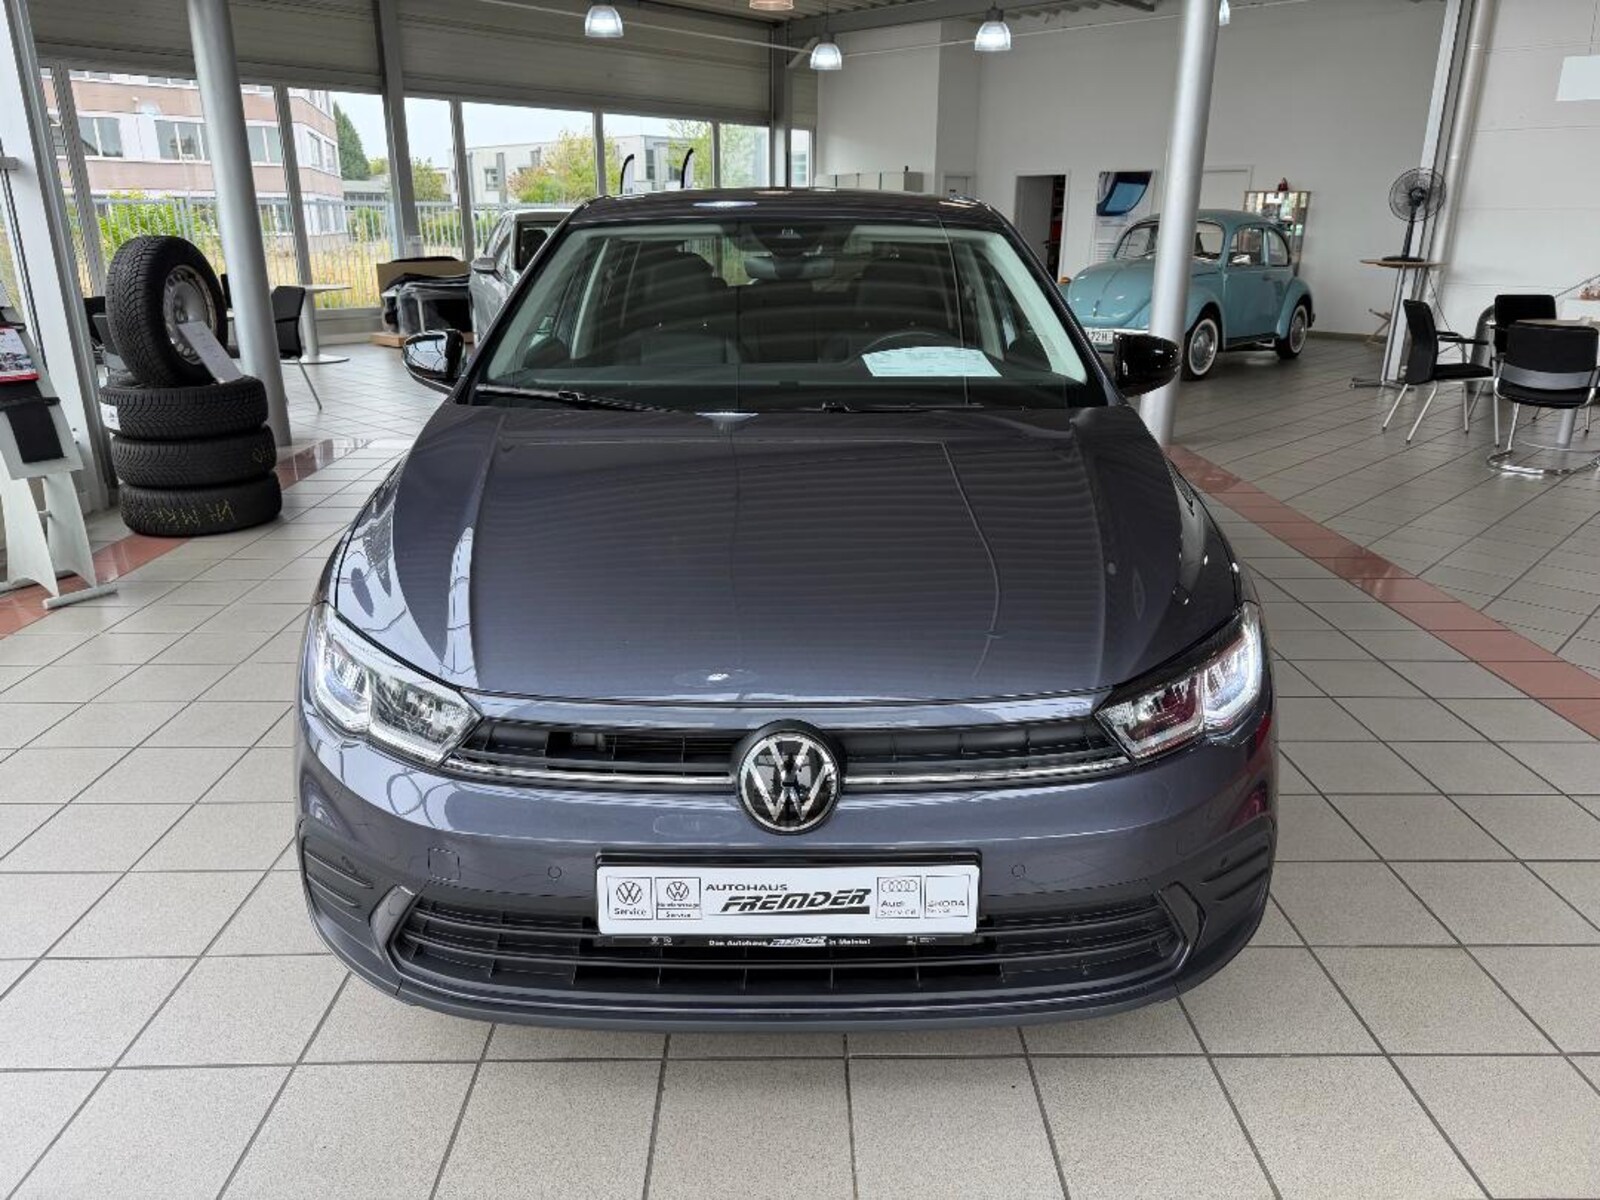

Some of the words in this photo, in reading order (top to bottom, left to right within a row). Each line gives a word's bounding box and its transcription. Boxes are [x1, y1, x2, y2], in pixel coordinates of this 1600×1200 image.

[705, 883, 788, 892] AUTOHAUS
[720, 888, 872, 913] FREMDER
[614, 907, 647, 917] Service
